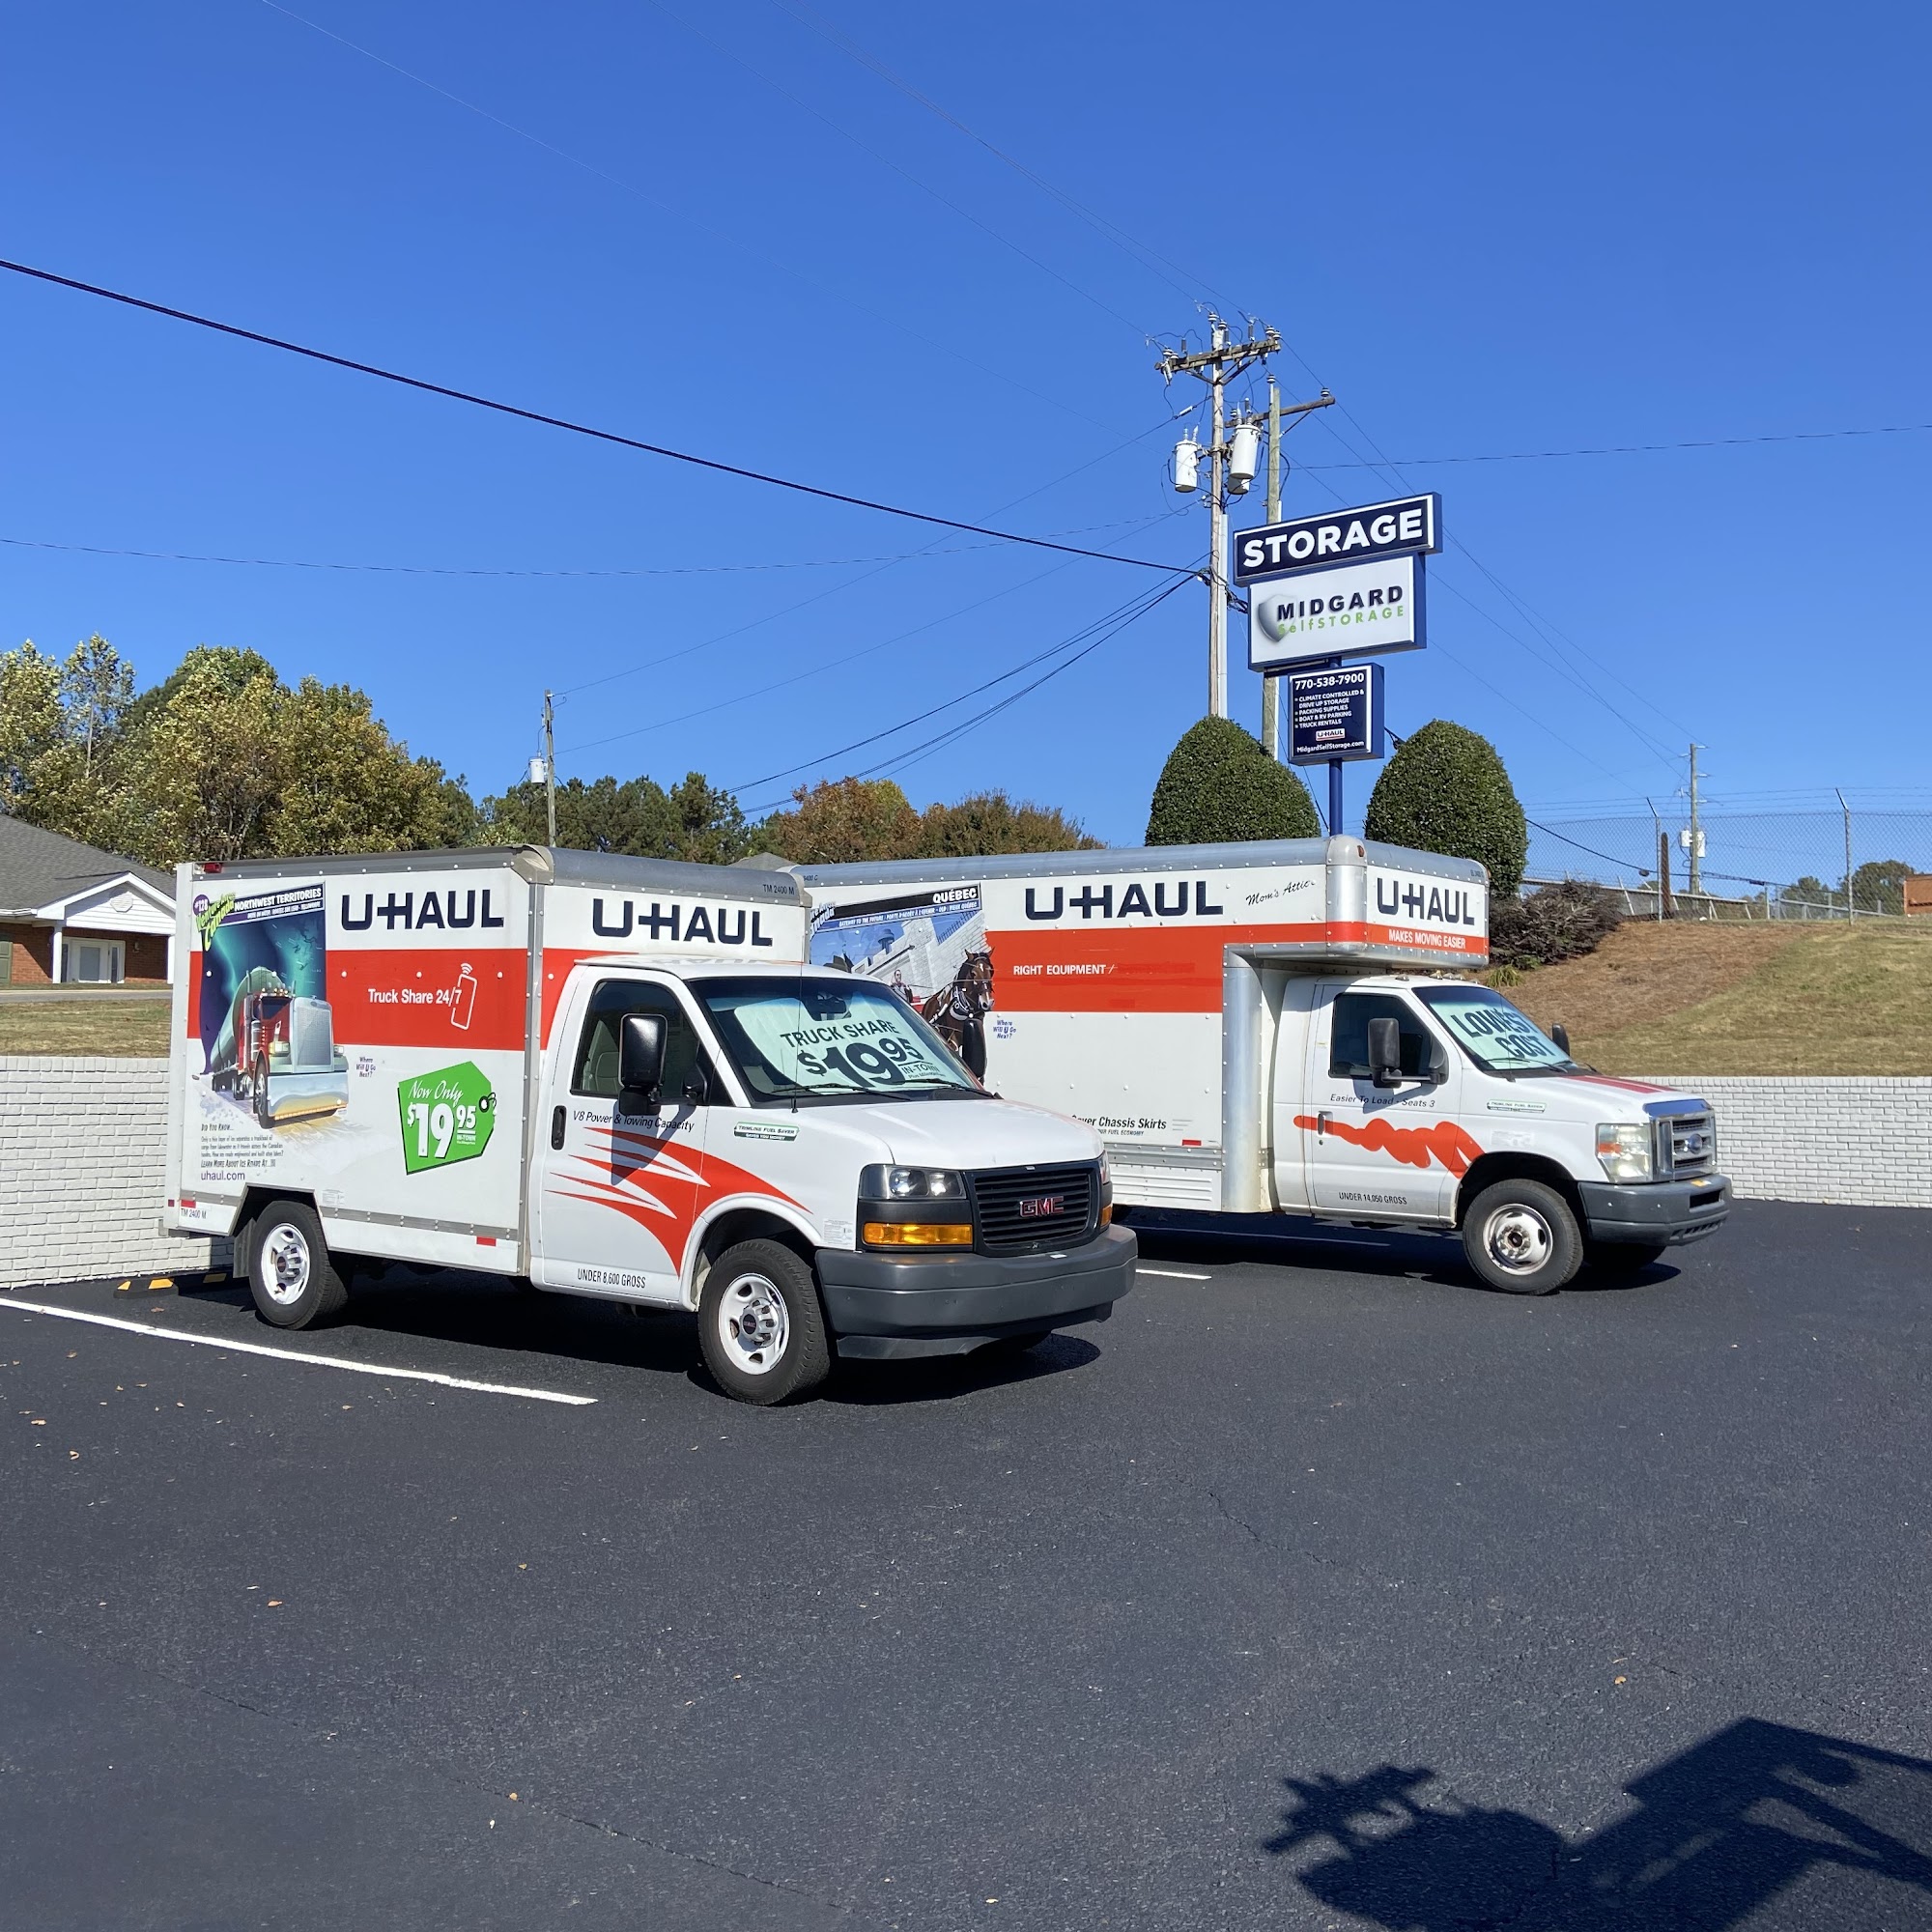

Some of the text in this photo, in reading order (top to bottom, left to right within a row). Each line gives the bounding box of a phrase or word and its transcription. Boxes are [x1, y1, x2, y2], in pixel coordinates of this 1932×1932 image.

[1243, 508, 1423, 568] STORAGE
[1277, 585, 1404, 622] MIDGARD
[1278, 606, 1405, 636] SelfSTORAGE
[1295, 672, 1365, 691] 770-538-7900
[1298, 694, 1321, 702] CLIMATE
[1321, 690, 1359, 699] CONTROLLED
[1323, 697, 1350, 706] STORAGE
[1298, 704, 1349, 716] PACKING SUPPLIES
[1327, 710, 1352, 719] PARKING
[1318, 718, 1343, 727] RENTALS
[1296, 741, 1365, 753] MidgardSelfStorage.com
[762, 884, 795, 895] TM 2400 M
[932, 888, 978, 904] QUÉBEC
[1245, 888, 1279, 906] Mom's
[234, 895, 275, 912] NORTHWEST
[276, 888, 322, 905] TERRITORIES
[341, 889, 505, 931] U-HAUL
[1025, 881, 1224, 921] U-HAUL
[1377, 877, 1475, 925] U-HAUL
[592, 897, 773, 947] U-HAUL
[1388, 928, 1466, 950] MAKES MOVING EASIER
[1013, 964, 1044, 976] RIGHT
[1046, 964, 1106, 976] EQUIPMENT
[368, 986, 463, 1007] Truck Share 24/7
[1450, 1008, 1539, 1038] LOWEST
[780, 1019, 901, 1048] TRUCK SHARE
[1494, 1034, 1556, 1059] COST
[901, 1064, 941, 1075] IN-TOWN
[408, 1079, 464, 1109] Now Only
[1330, 1094, 1436, 1108] Easier To Load Seats 3
[573, 1110, 585, 1122] V8
[585, 1111, 612, 1123] Power
[613, 1115, 621, 1124] &
[654, 1117, 696, 1133] Capacity
[1098, 1116, 1136, 1128] Chassis
[1137, 1118, 1167, 1130] Skirts
[200, 1170, 245, 1180] uhaul.com
[1019, 1195, 1065, 1218] GMC
[1338, 1191, 1363, 1202] UNDER
[1383, 1195, 1407, 1206] GROSS
[181, 1208, 207, 1220] TM 2400 M
[577, 1267, 646, 1289] UNDER 8,600 GROSS
